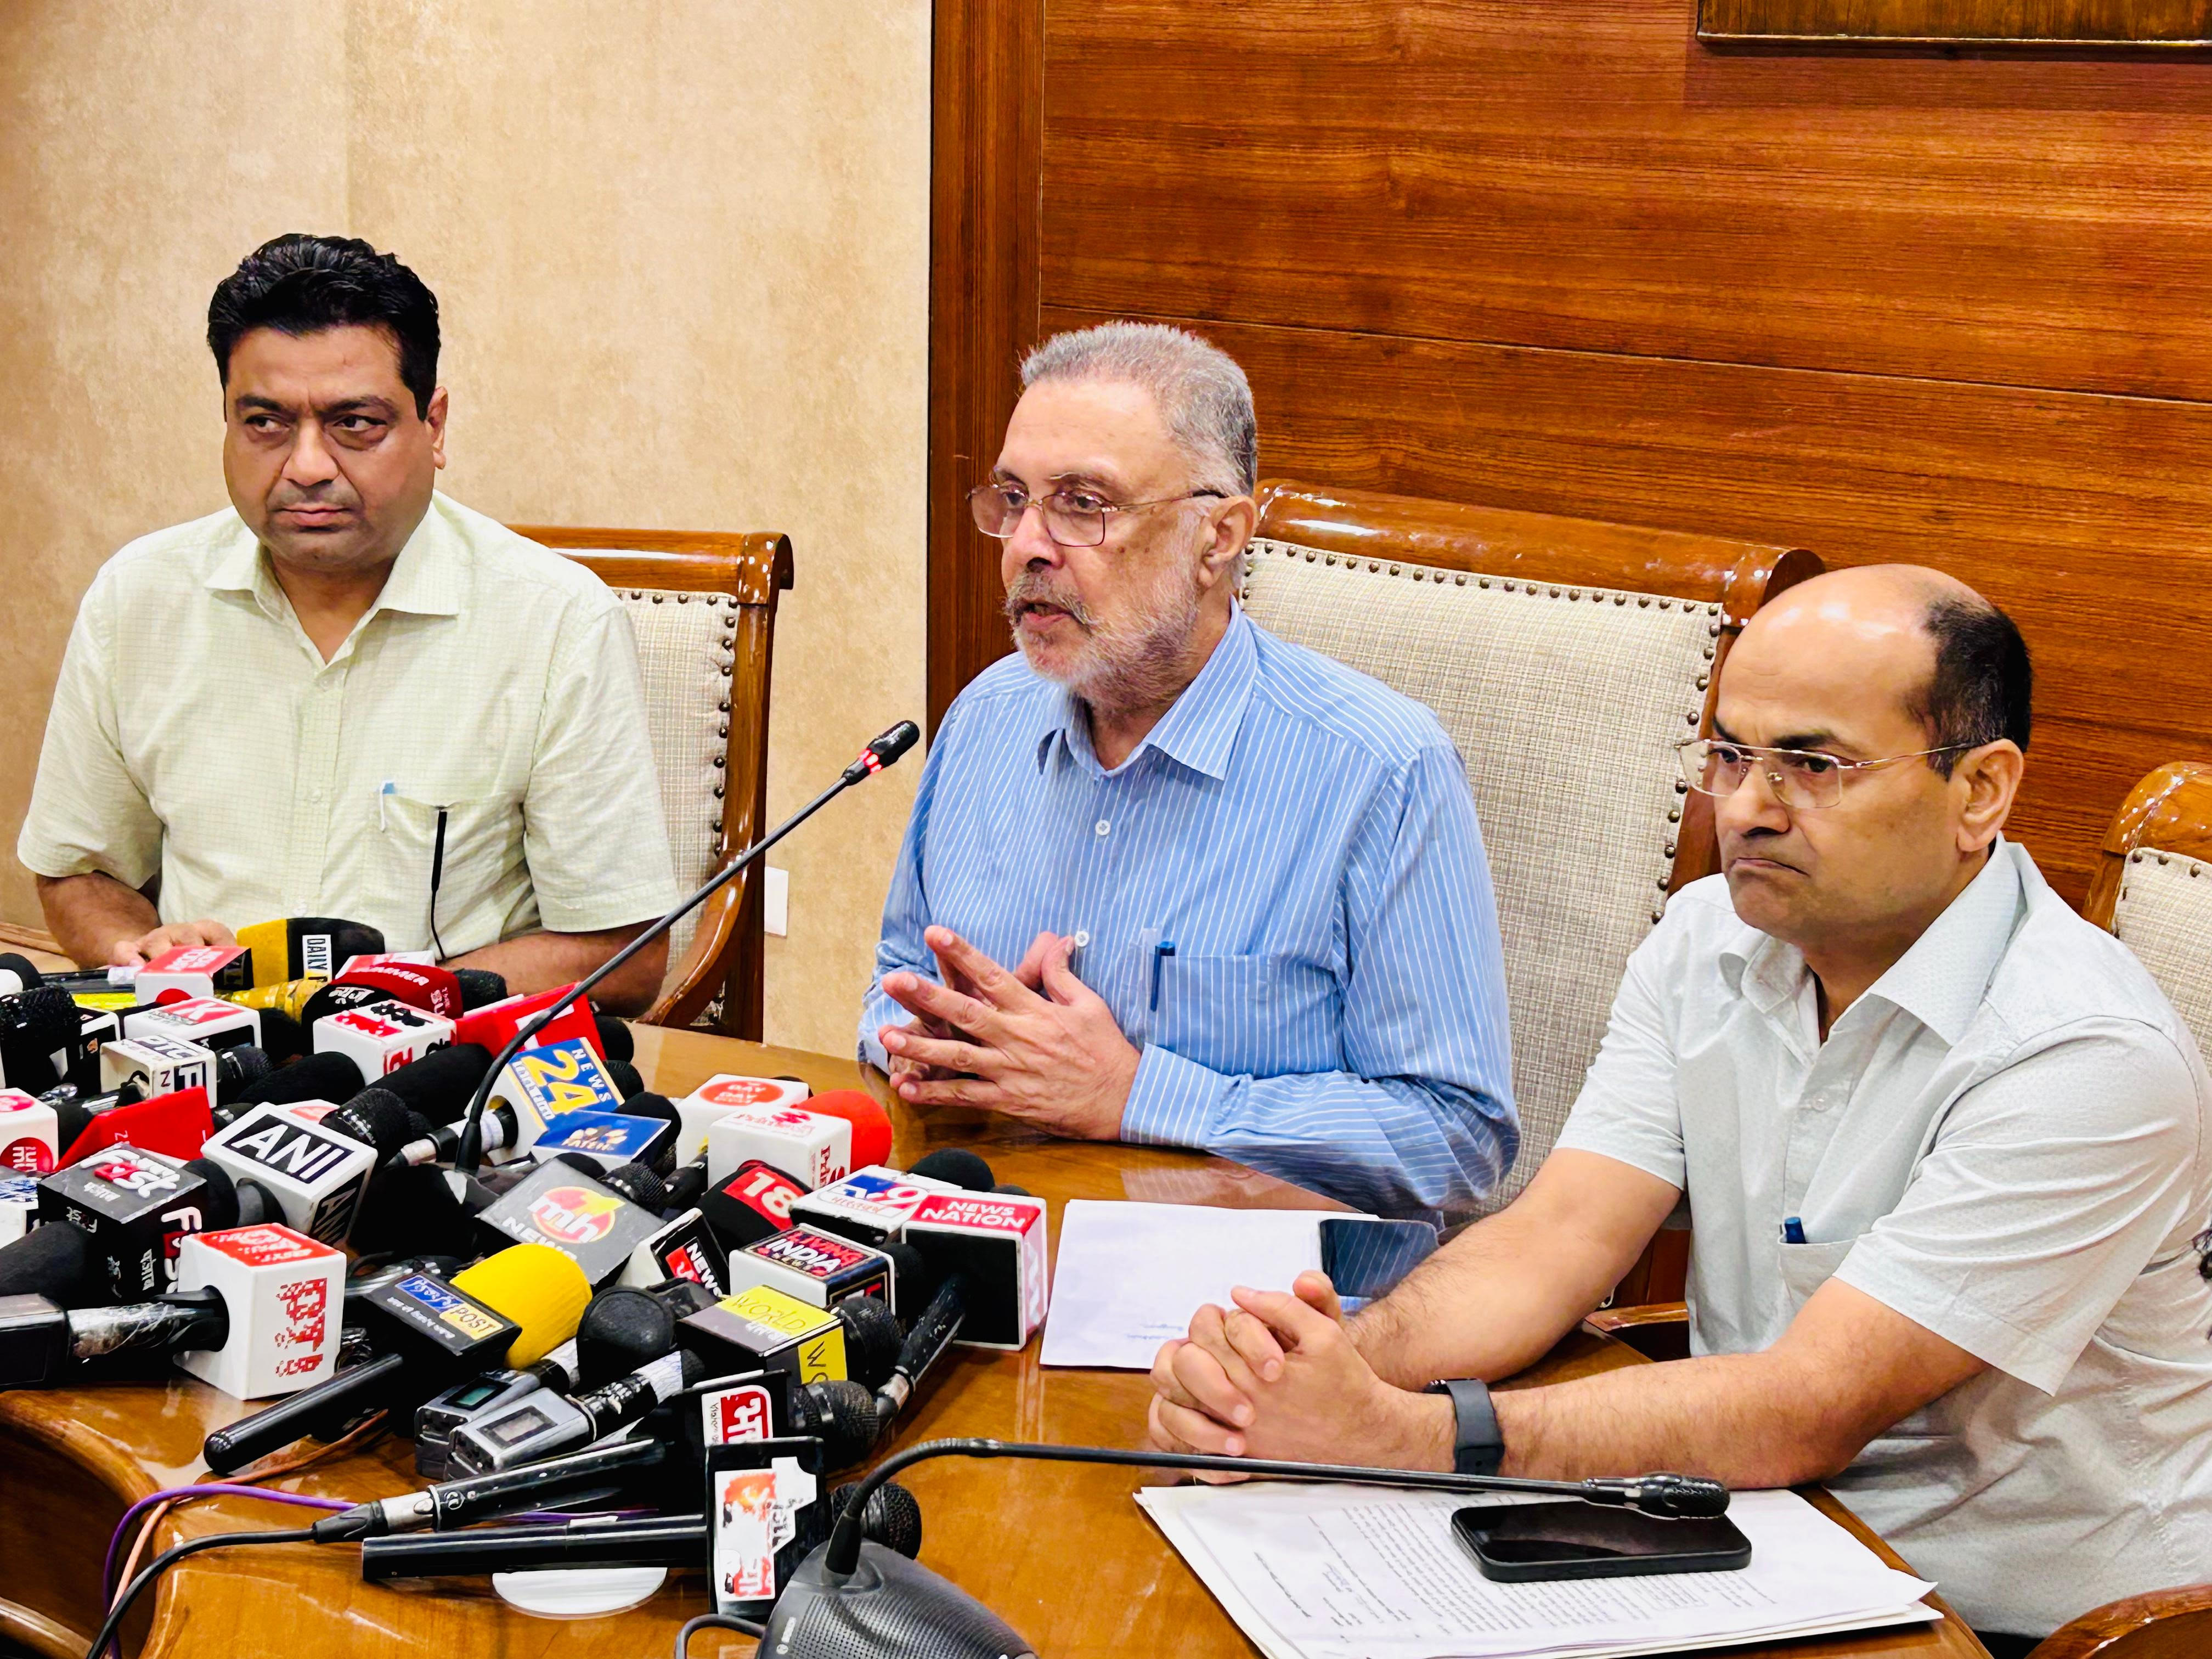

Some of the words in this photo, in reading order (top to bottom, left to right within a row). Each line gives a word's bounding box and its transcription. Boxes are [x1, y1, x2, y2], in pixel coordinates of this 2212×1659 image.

[307, 938, 328, 970] DAILY
[133, 1035, 200, 1060] PTC
[521, 1048, 600, 1115] 24
[572, 1048, 612, 1103] NEWS
[230, 1123, 345, 1181] ANI
[742, 1171, 797, 1218] 18
[946, 1200, 1015, 1216] NEWS
[921, 1207, 1026, 1228] NATION
[765, 1238, 842, 1273] INDIA
[787, 1231, 864, 1268] LIVING
[449, 1307, 496, 1333] POST
[732, 1295, 806, 1330] WORLD
